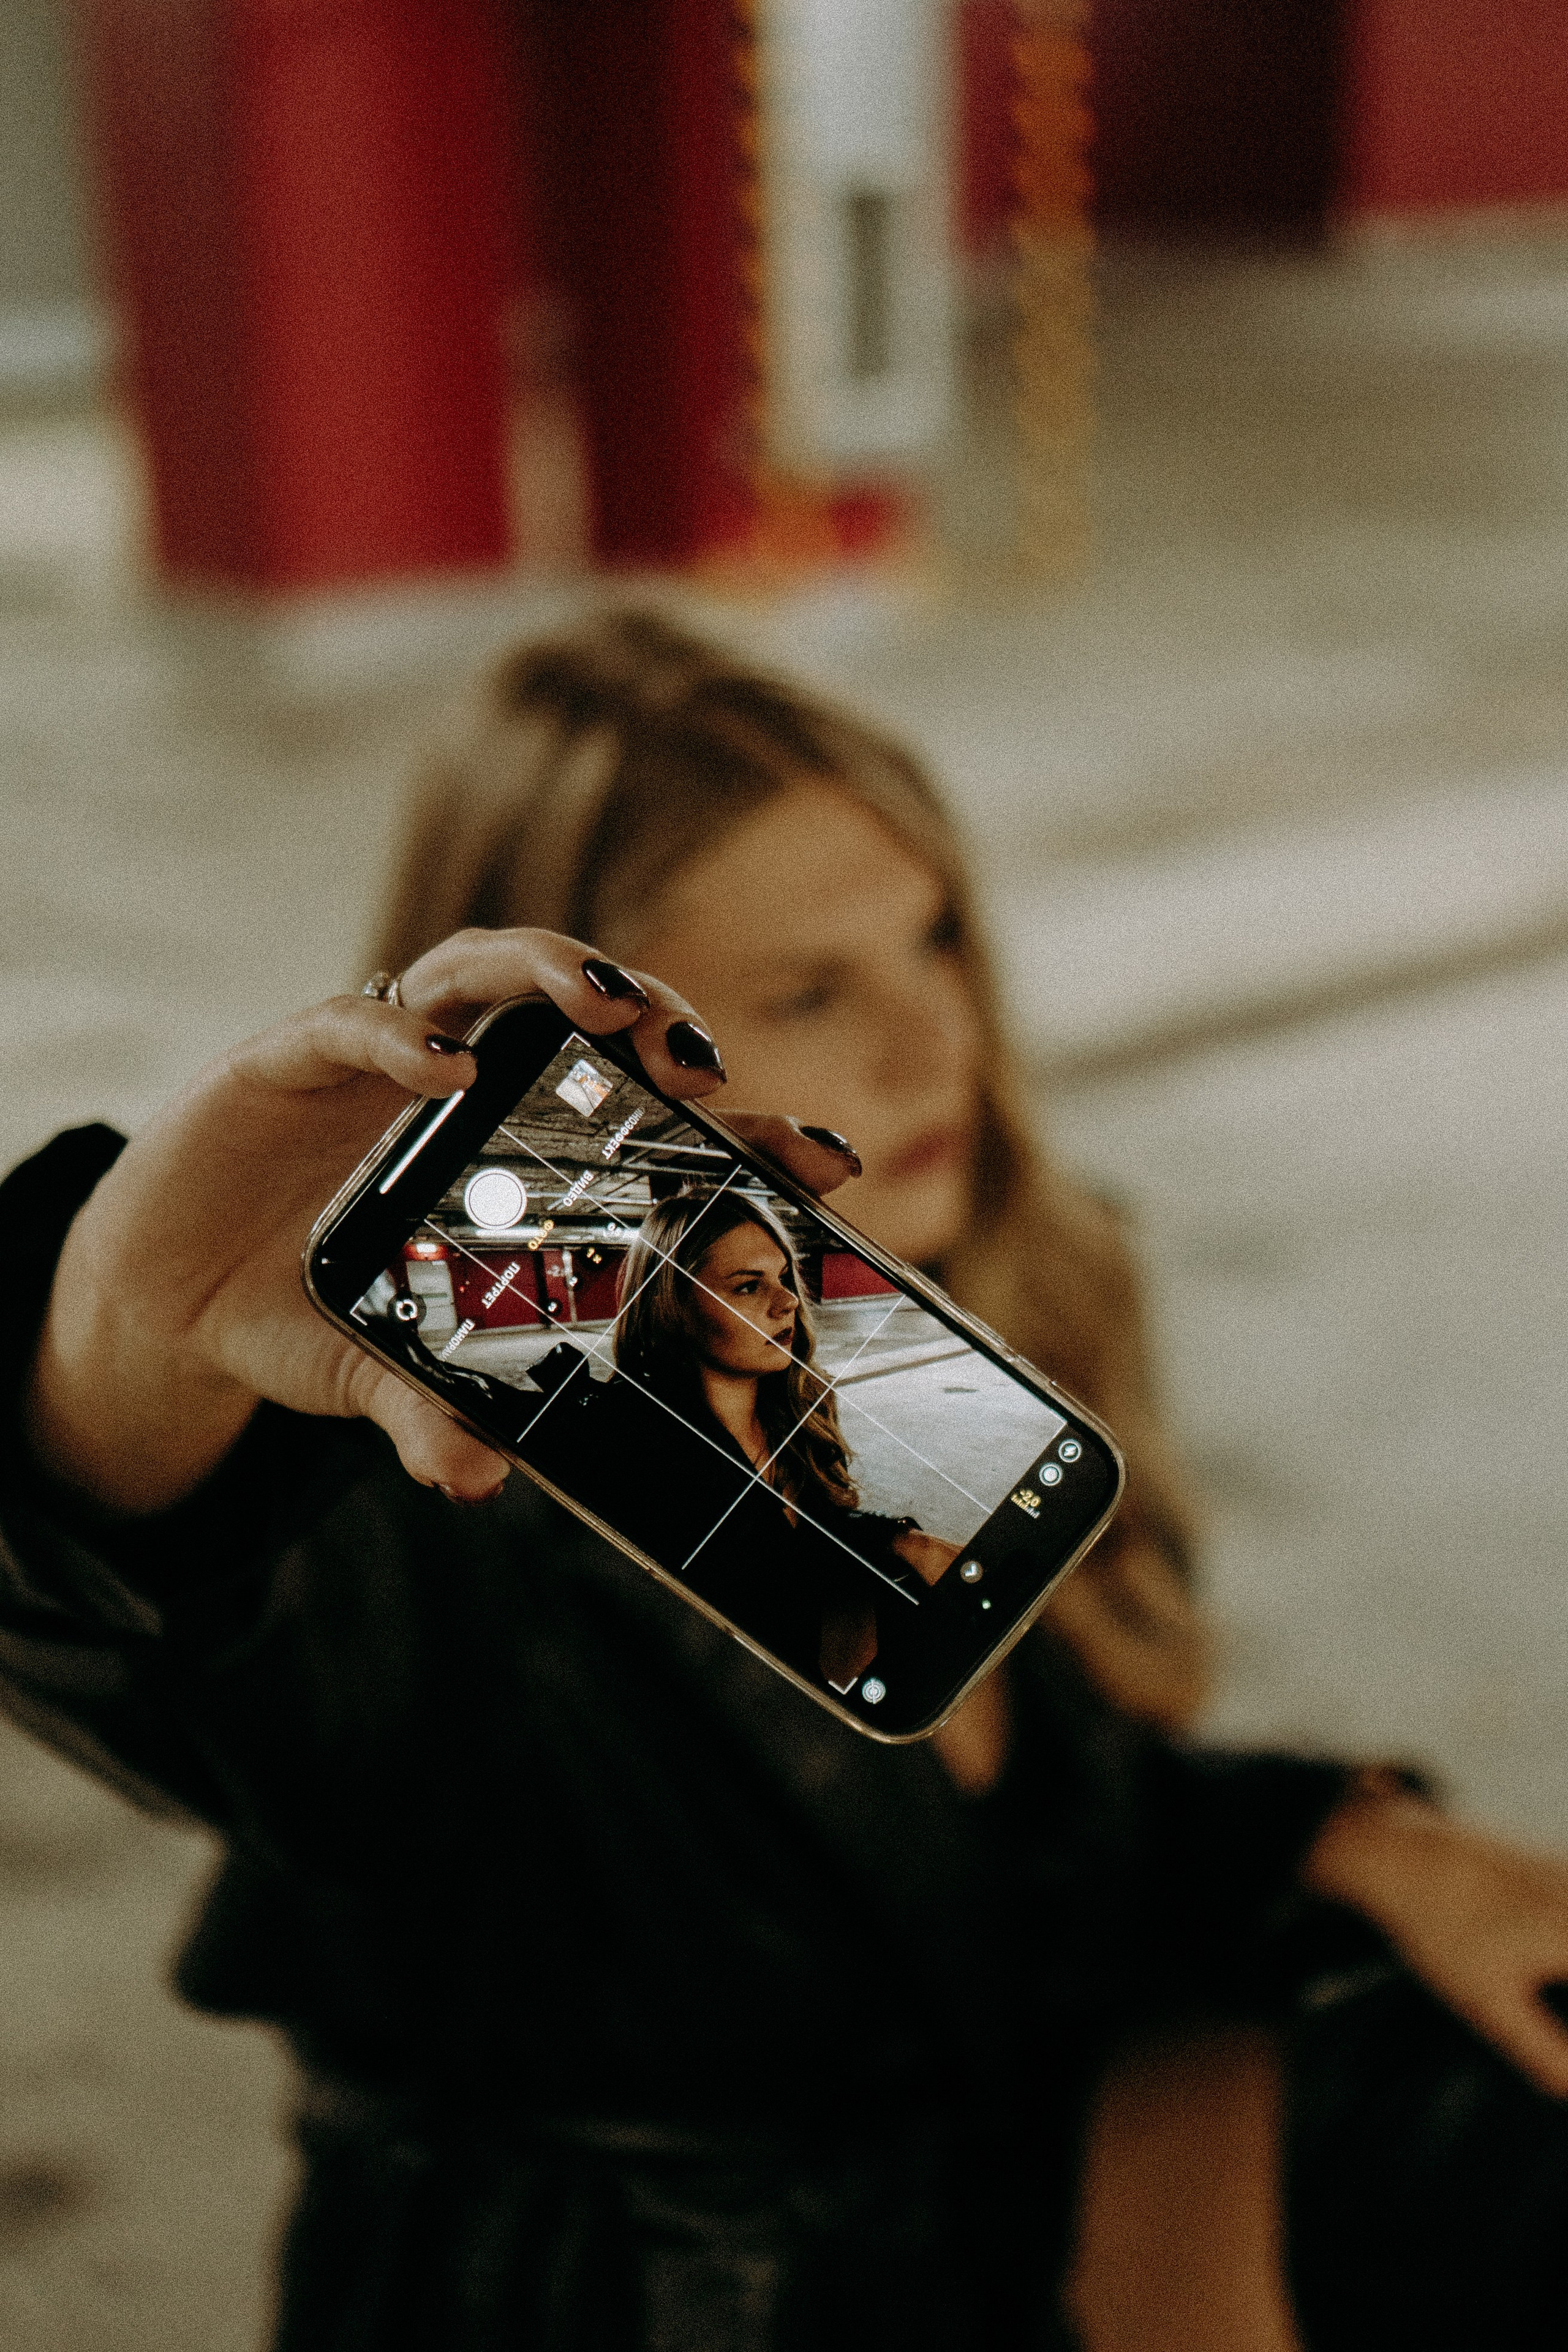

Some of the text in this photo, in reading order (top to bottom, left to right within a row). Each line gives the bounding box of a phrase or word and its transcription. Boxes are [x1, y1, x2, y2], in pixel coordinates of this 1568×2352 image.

[562, 1169, 595, 1207] ВИДЕО
[527, 1218, 556, 1251] ФОТО
[480, 1262, 521, 1308] ПОРТРЕТ
[568, 1275, 579, 1287] 2
[547, 1301, 557, 1311] 3
